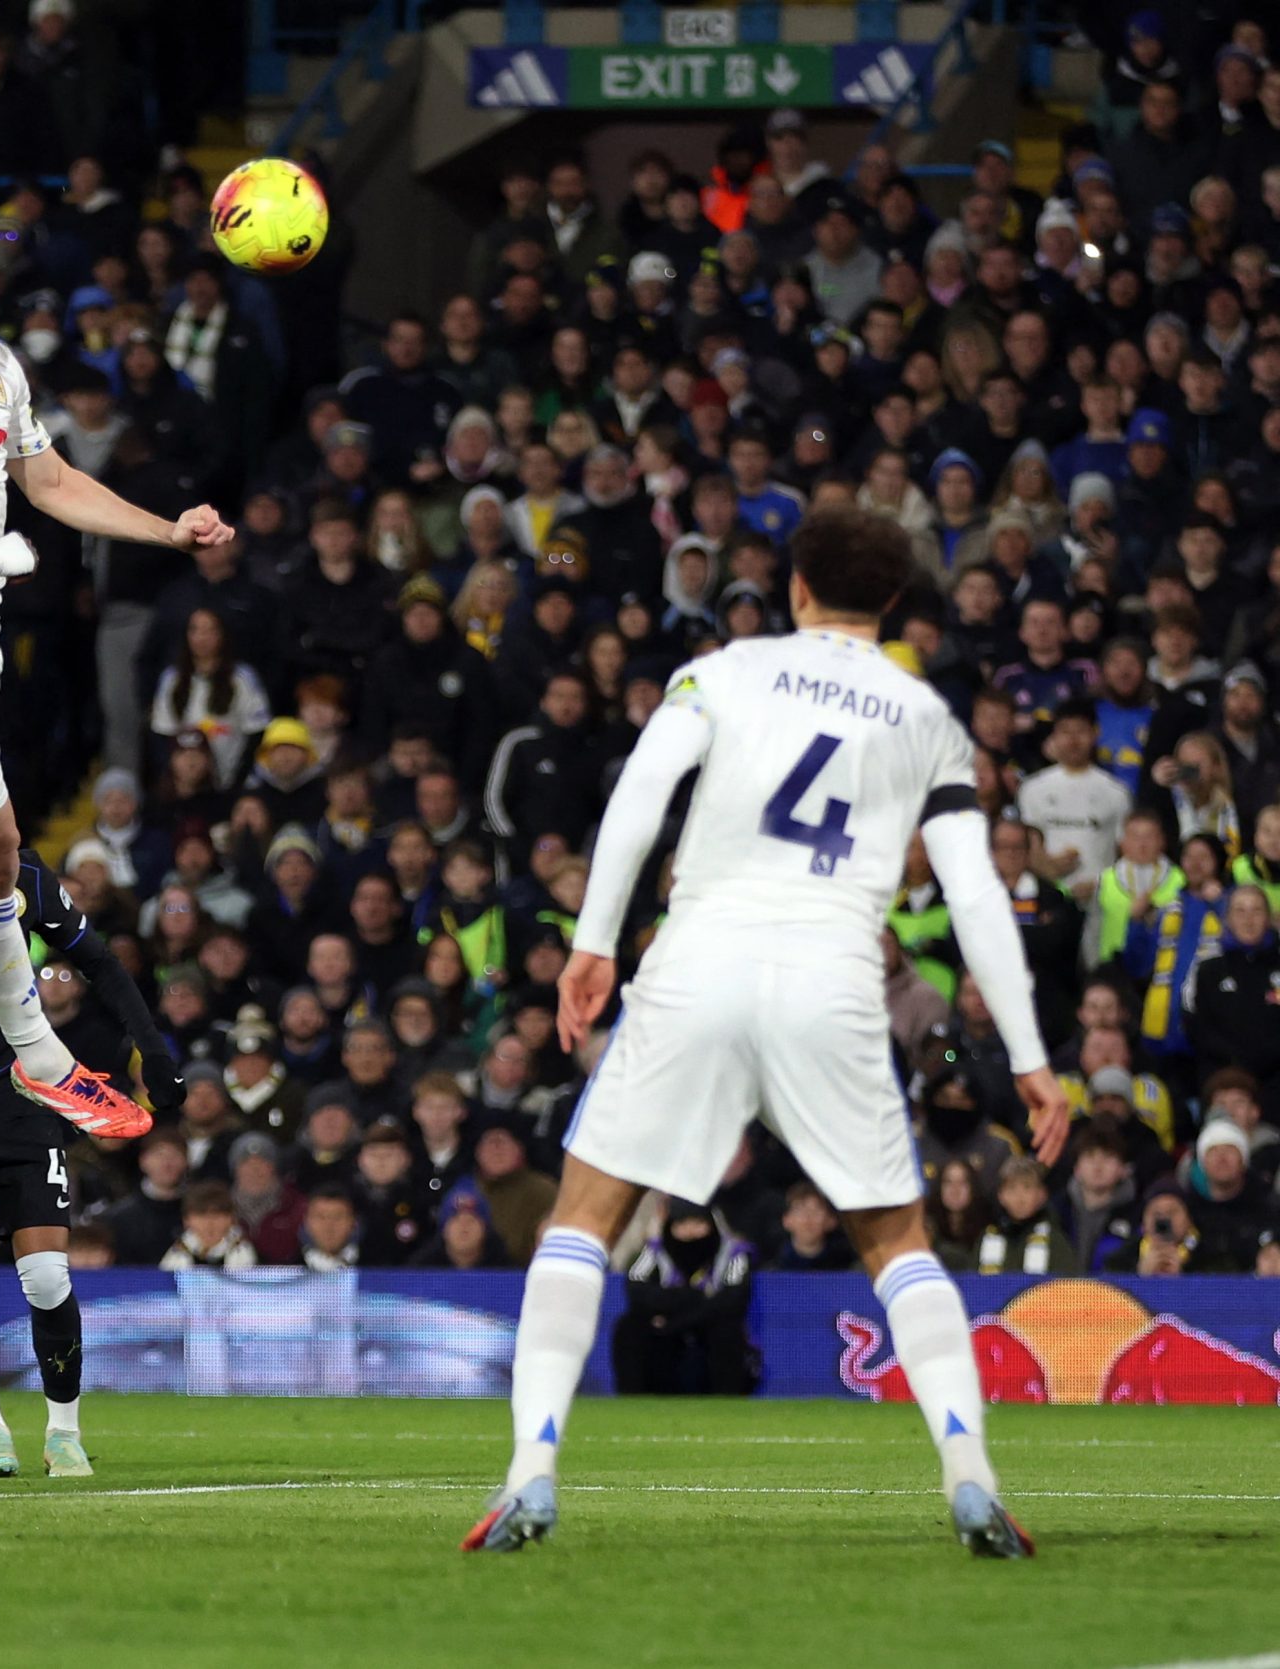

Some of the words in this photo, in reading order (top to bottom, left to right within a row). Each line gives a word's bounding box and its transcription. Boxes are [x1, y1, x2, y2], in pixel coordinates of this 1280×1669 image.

[602, 55, 716, 98] EXIT
[773, 671, 904, 727] AMPADU
[760, 732, 855, 876] 4
[47, 1147, 69, 1193] 4
